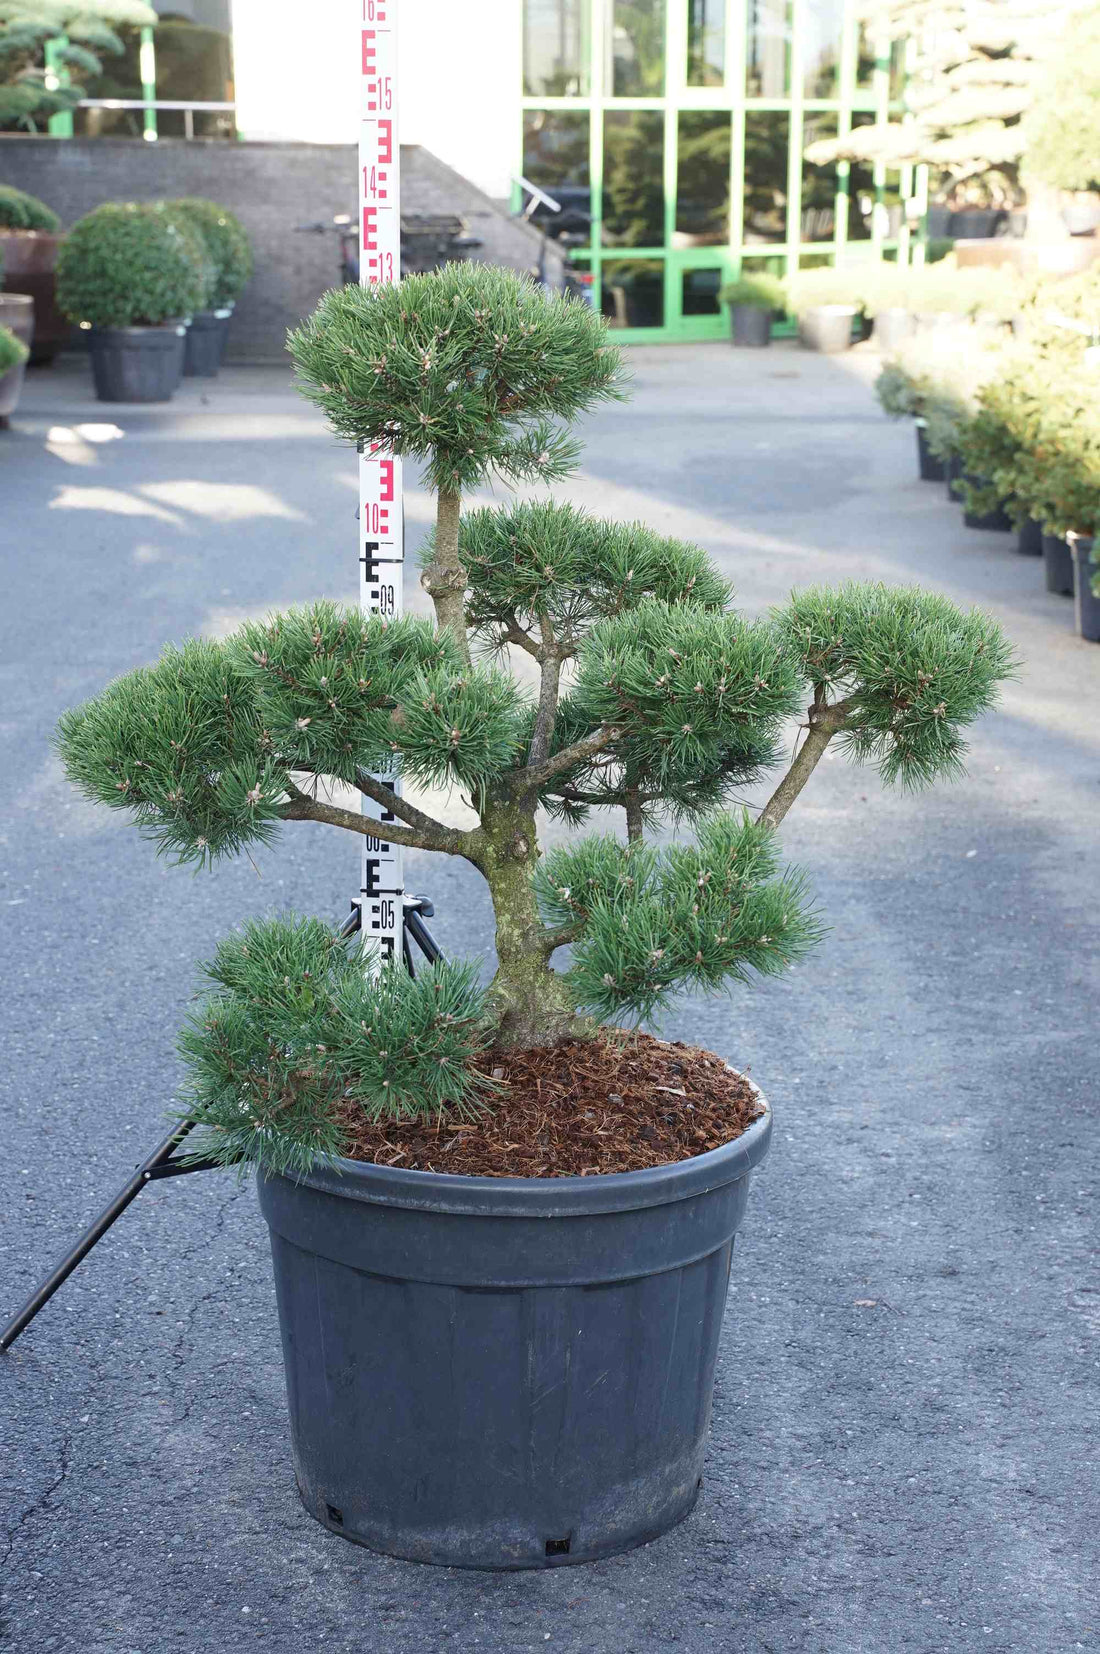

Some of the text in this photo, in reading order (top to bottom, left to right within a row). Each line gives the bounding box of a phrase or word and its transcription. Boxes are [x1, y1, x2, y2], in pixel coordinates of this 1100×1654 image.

[362, 0, 375, 22] 16
[377, 77, 392, 111] 15
[362, 166, 377, 200] 14
[378, 252, 393, 283] 13
[364, 502, 379, 534] 10
[380, 585, 394, 616] 09
[380, 899, 395, 929] 05
